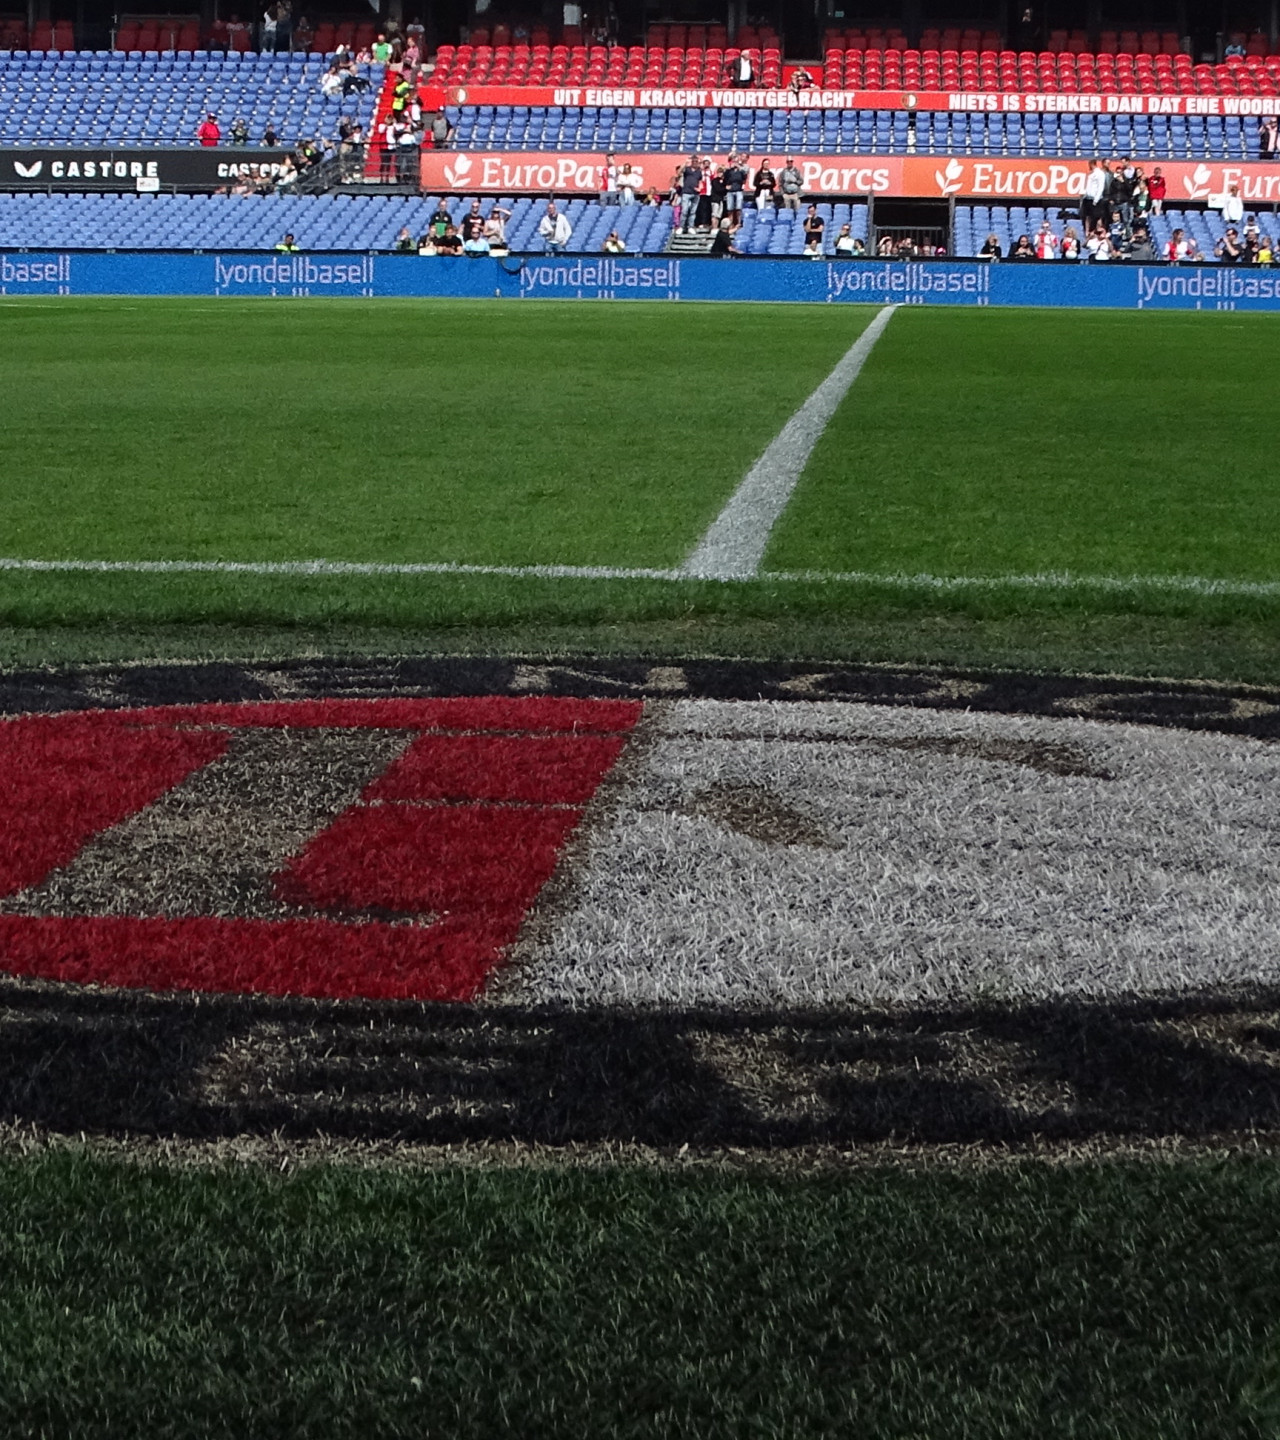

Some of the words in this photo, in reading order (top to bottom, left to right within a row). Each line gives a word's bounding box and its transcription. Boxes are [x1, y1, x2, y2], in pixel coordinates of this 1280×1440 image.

[554, 90, 581, 106] UIT
[586, 90, 635, 106] EIGEN
[639, 91, 708, 107] KRACHT
[712, 91, 855, 109] VOORTGEBRACHT
[949, 94, 997, 110] NIETS
[1003, 95, 1020, 110] IS
[1025, 95, 1101, 112] STERKER
[1107, 96, 1143, 112] DAN
[1148, 97, 1180, 113] DAT
[1186, 98, 1219, 114] ENE
[51, 161, 158, 177] CASTORE
[480, 158, 643, 189] EuroPas
[972, 163, 1087, 194] EuroPa
[215, 256, 374, 287] lyondellbasell
[520, 259, 680, 290] lyondellbasell
[826, 262, 989, 295] lyondellbasell
